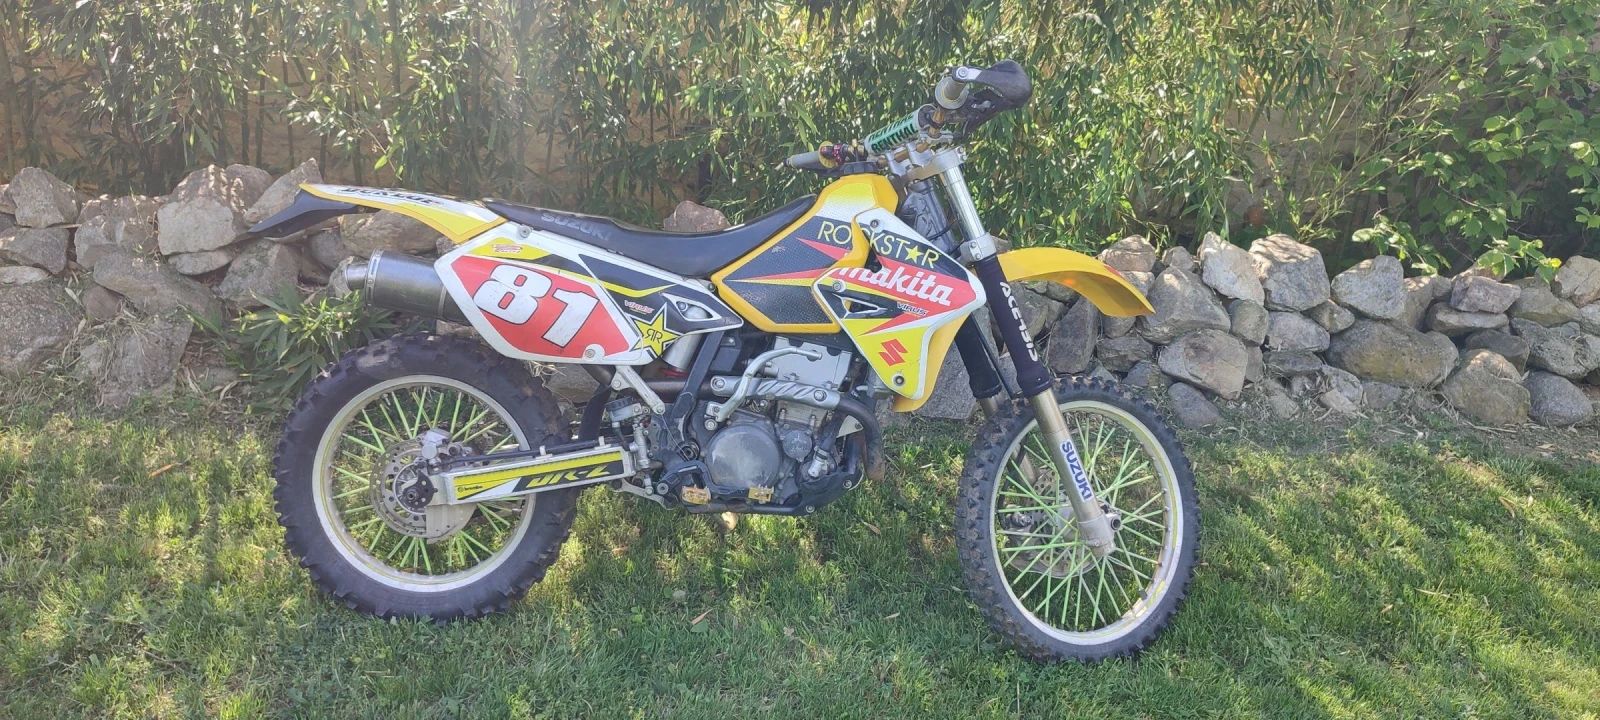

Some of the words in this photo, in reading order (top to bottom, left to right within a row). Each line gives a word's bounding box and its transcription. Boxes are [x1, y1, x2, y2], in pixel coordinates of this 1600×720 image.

[871, 123, 918, 153] RENTHAL
[541, 212, 612, 241] SUZUKI
[472, 263, 600, 348] 81
[897, 301, 930, 317] VIRUS
[1061, 441, 1093, 500] SUZUKI
